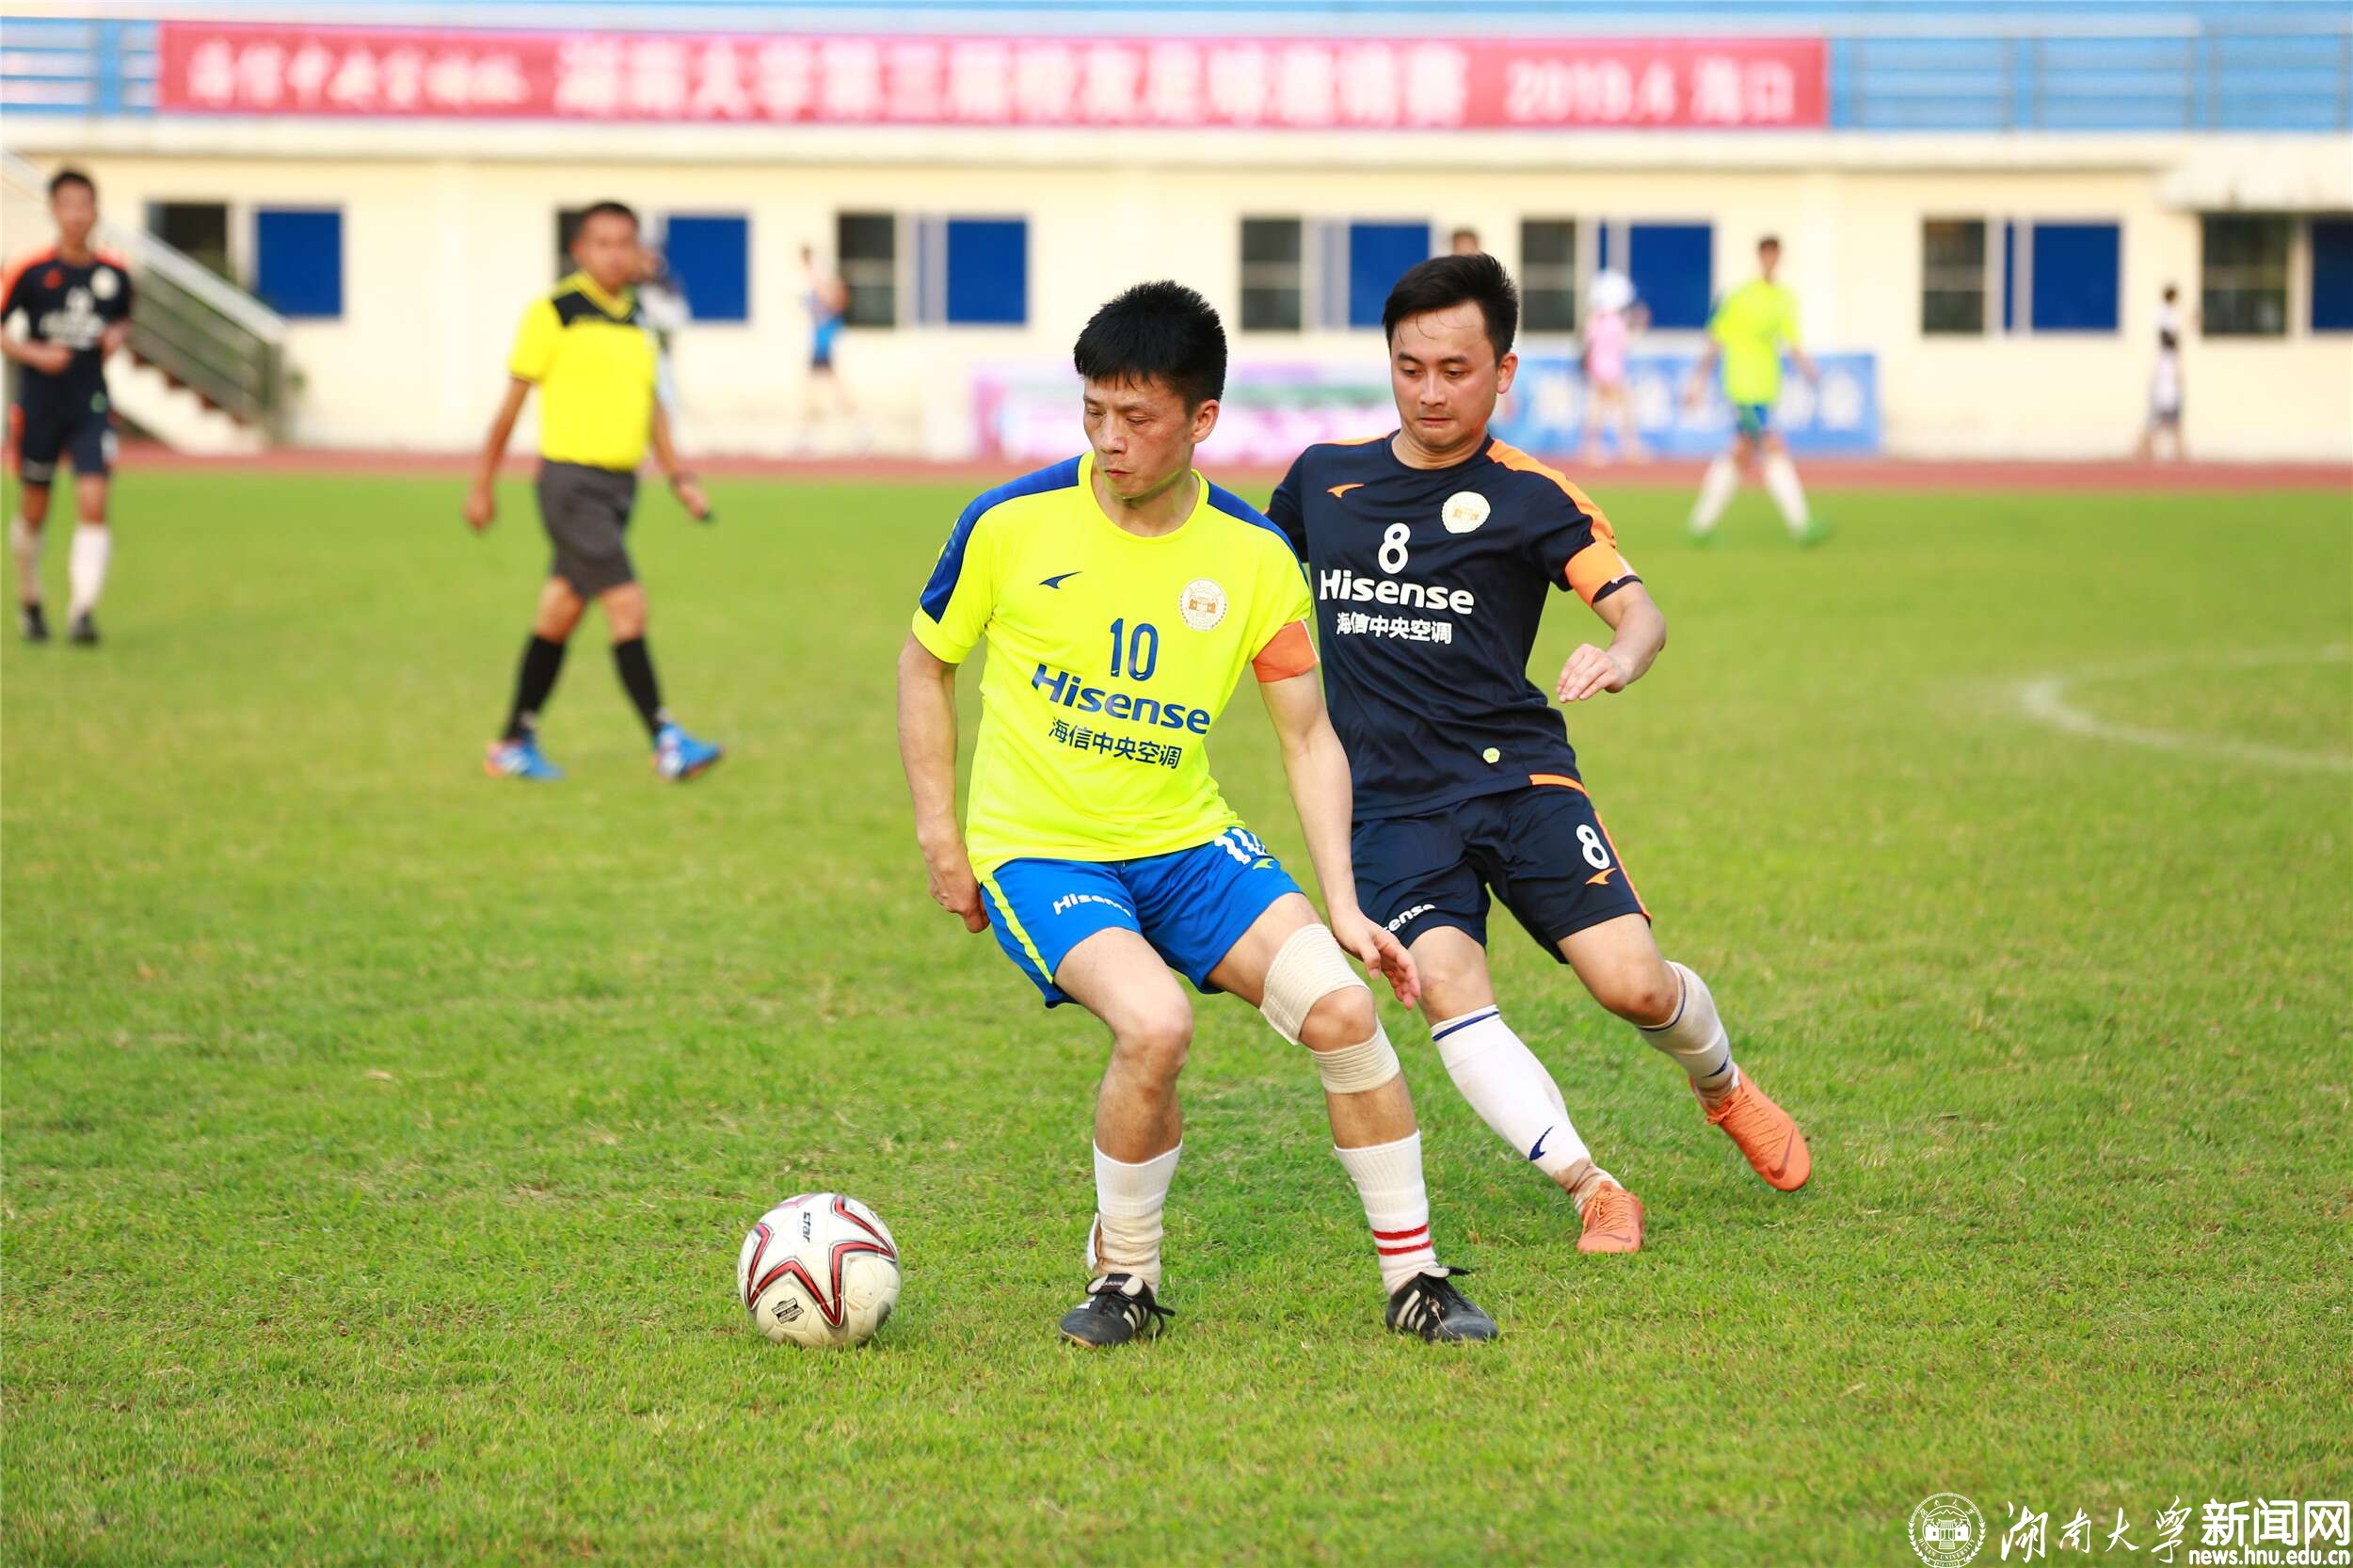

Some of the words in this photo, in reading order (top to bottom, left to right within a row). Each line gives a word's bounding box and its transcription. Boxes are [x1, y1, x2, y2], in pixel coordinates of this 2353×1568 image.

[1378, 522, 1411, 574] 8
[1319, 568, 1475, 615] Hisense
[1110, 617, 1159, 681] 10
[1337, 612, 1452, 645] 海信中央空调
[1032, 663, 1210, 734] Hisense
[1048, 719, 1182, 769] 海信中央空调
[1576, 824, 1610, 870] 8
